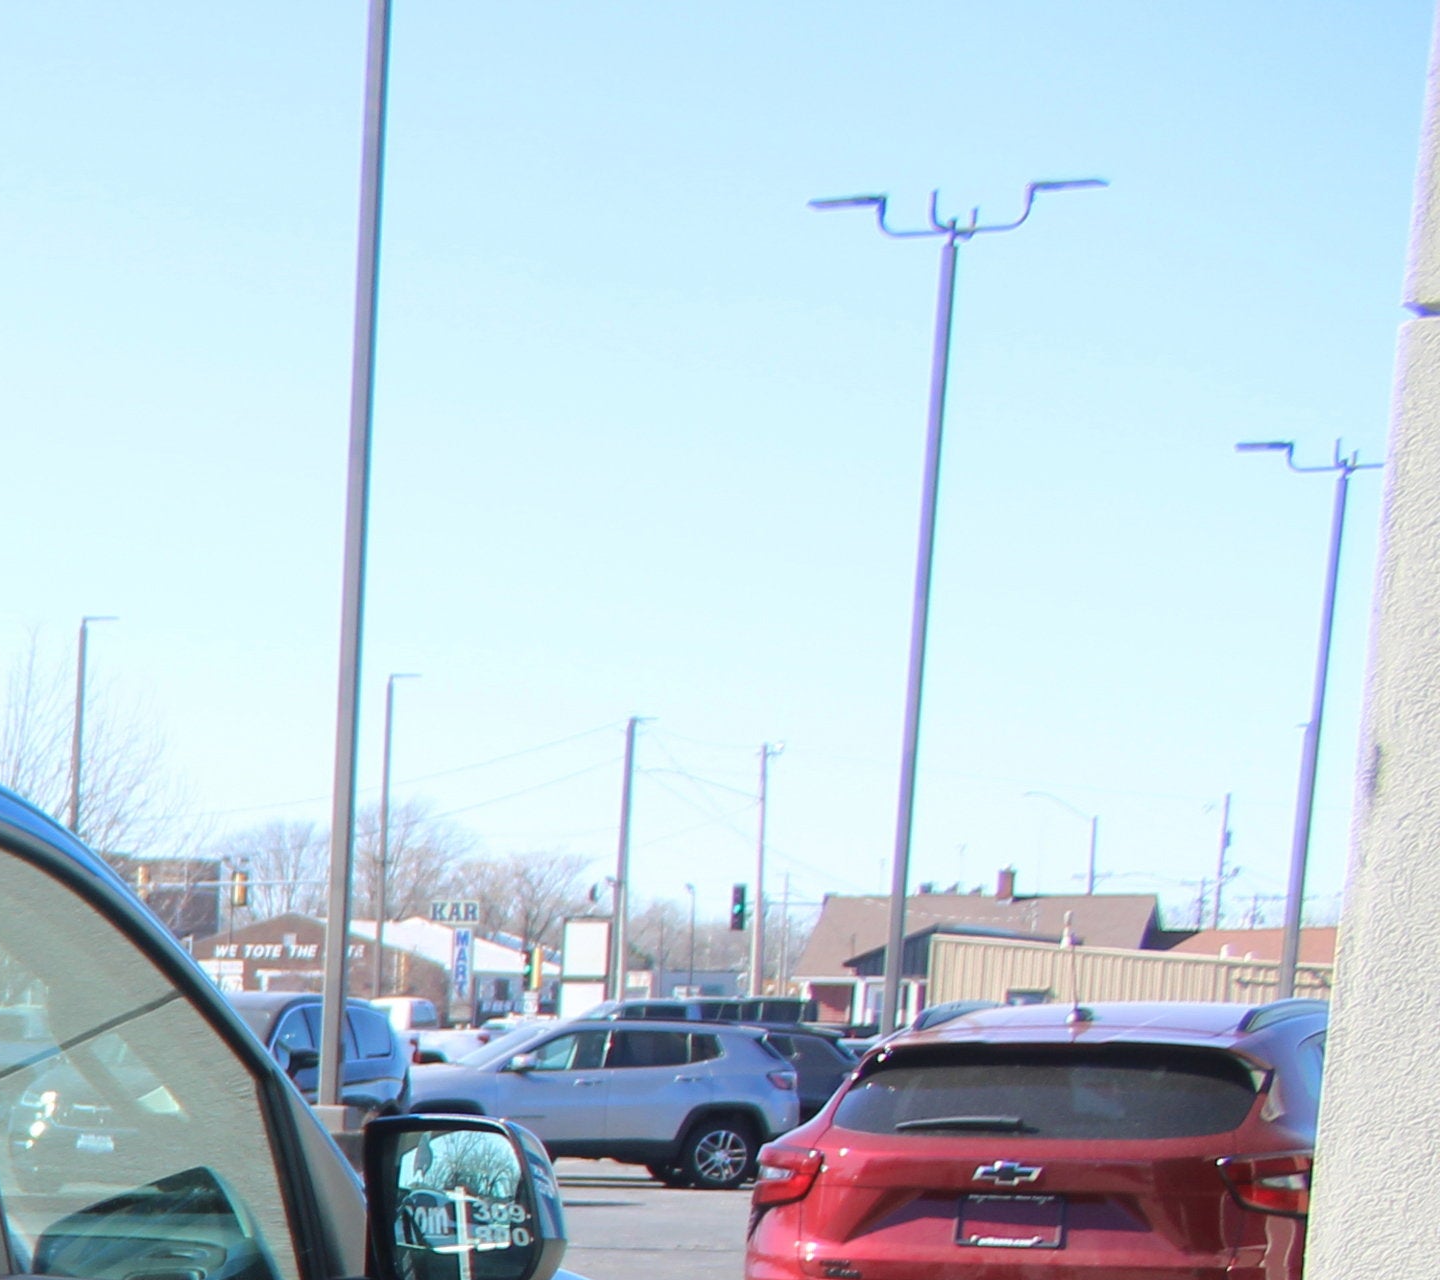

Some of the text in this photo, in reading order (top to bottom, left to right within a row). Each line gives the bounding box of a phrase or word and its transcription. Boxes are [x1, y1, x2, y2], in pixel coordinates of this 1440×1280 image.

[432, 902, 478, 921] KAR
[214, 944, 238, 959] WE
[244, 944, 282, 959] TOTE
[289, 944, 318, 959] THE
[454, 930, 470, 997] MART
